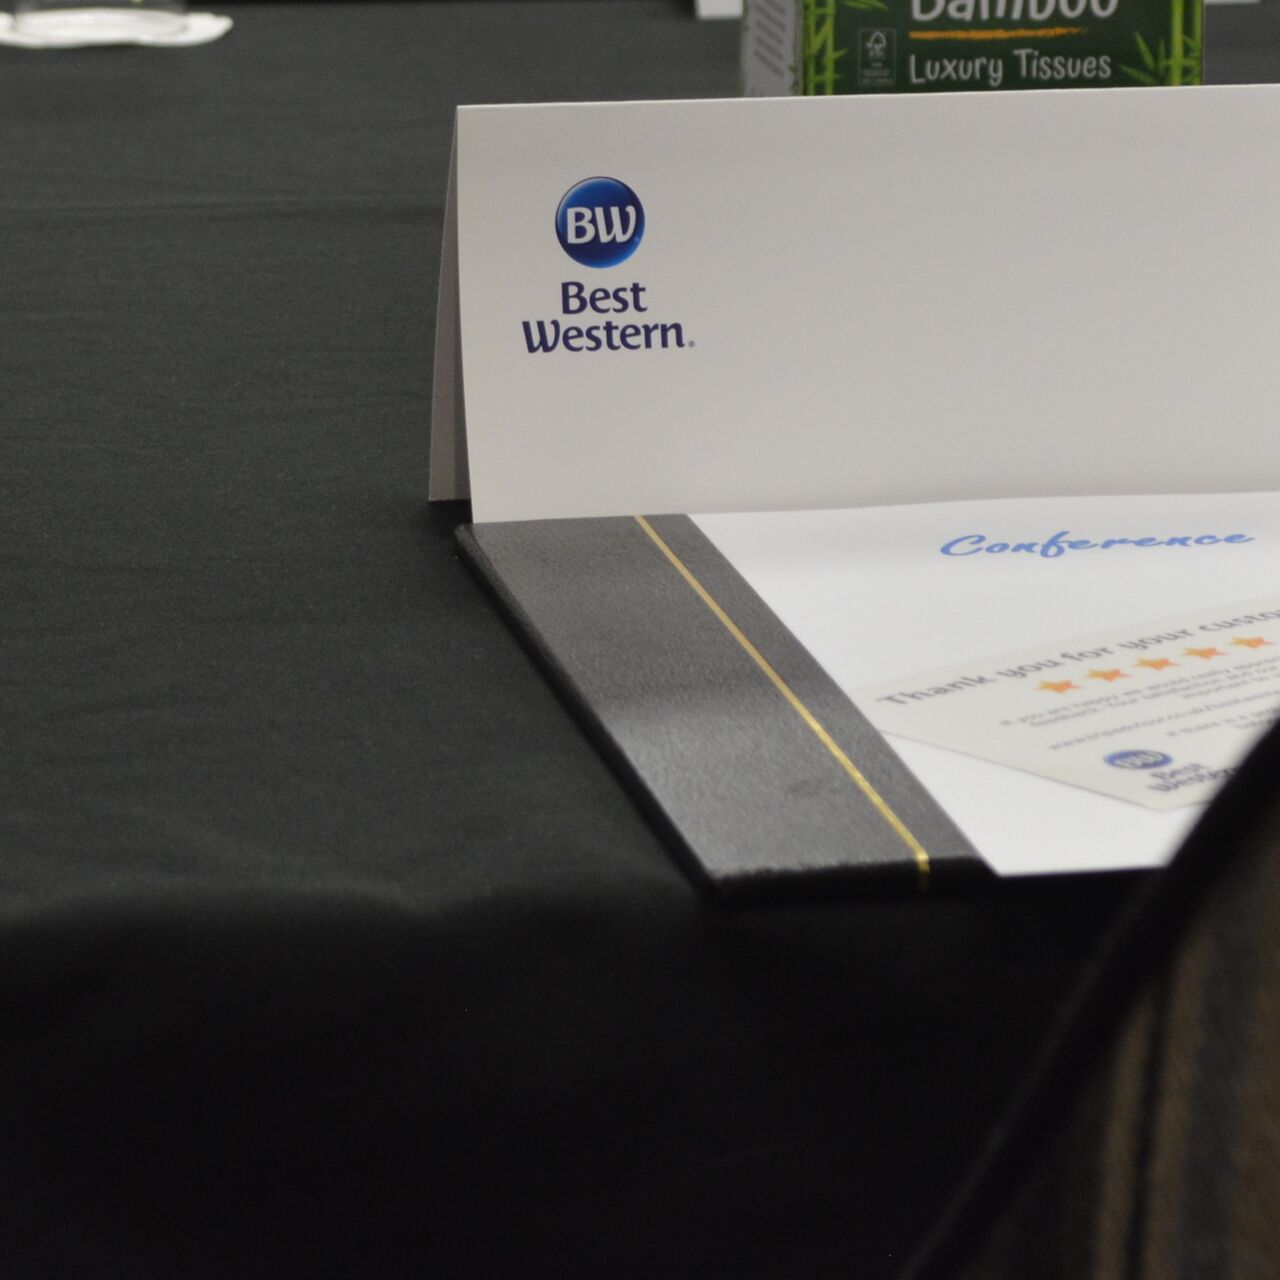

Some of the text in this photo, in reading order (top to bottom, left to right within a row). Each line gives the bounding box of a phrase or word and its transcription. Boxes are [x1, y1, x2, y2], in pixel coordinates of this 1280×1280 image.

[909, 54, 1003, 87] Luxury
[1014, 48, 1111, 79] Tissues
[567, 205, 637, 244] BW
[561, 281, 648, 314] Best
[522, 319, 686, 353] Western
[940, 531, 1256, 558] Conference
[876, 674, 997, 705] Thank
[996, 658, 1063, 678] you
[1060, 646, 1114, 662] for
[1119, 627, 1194, 651] your
